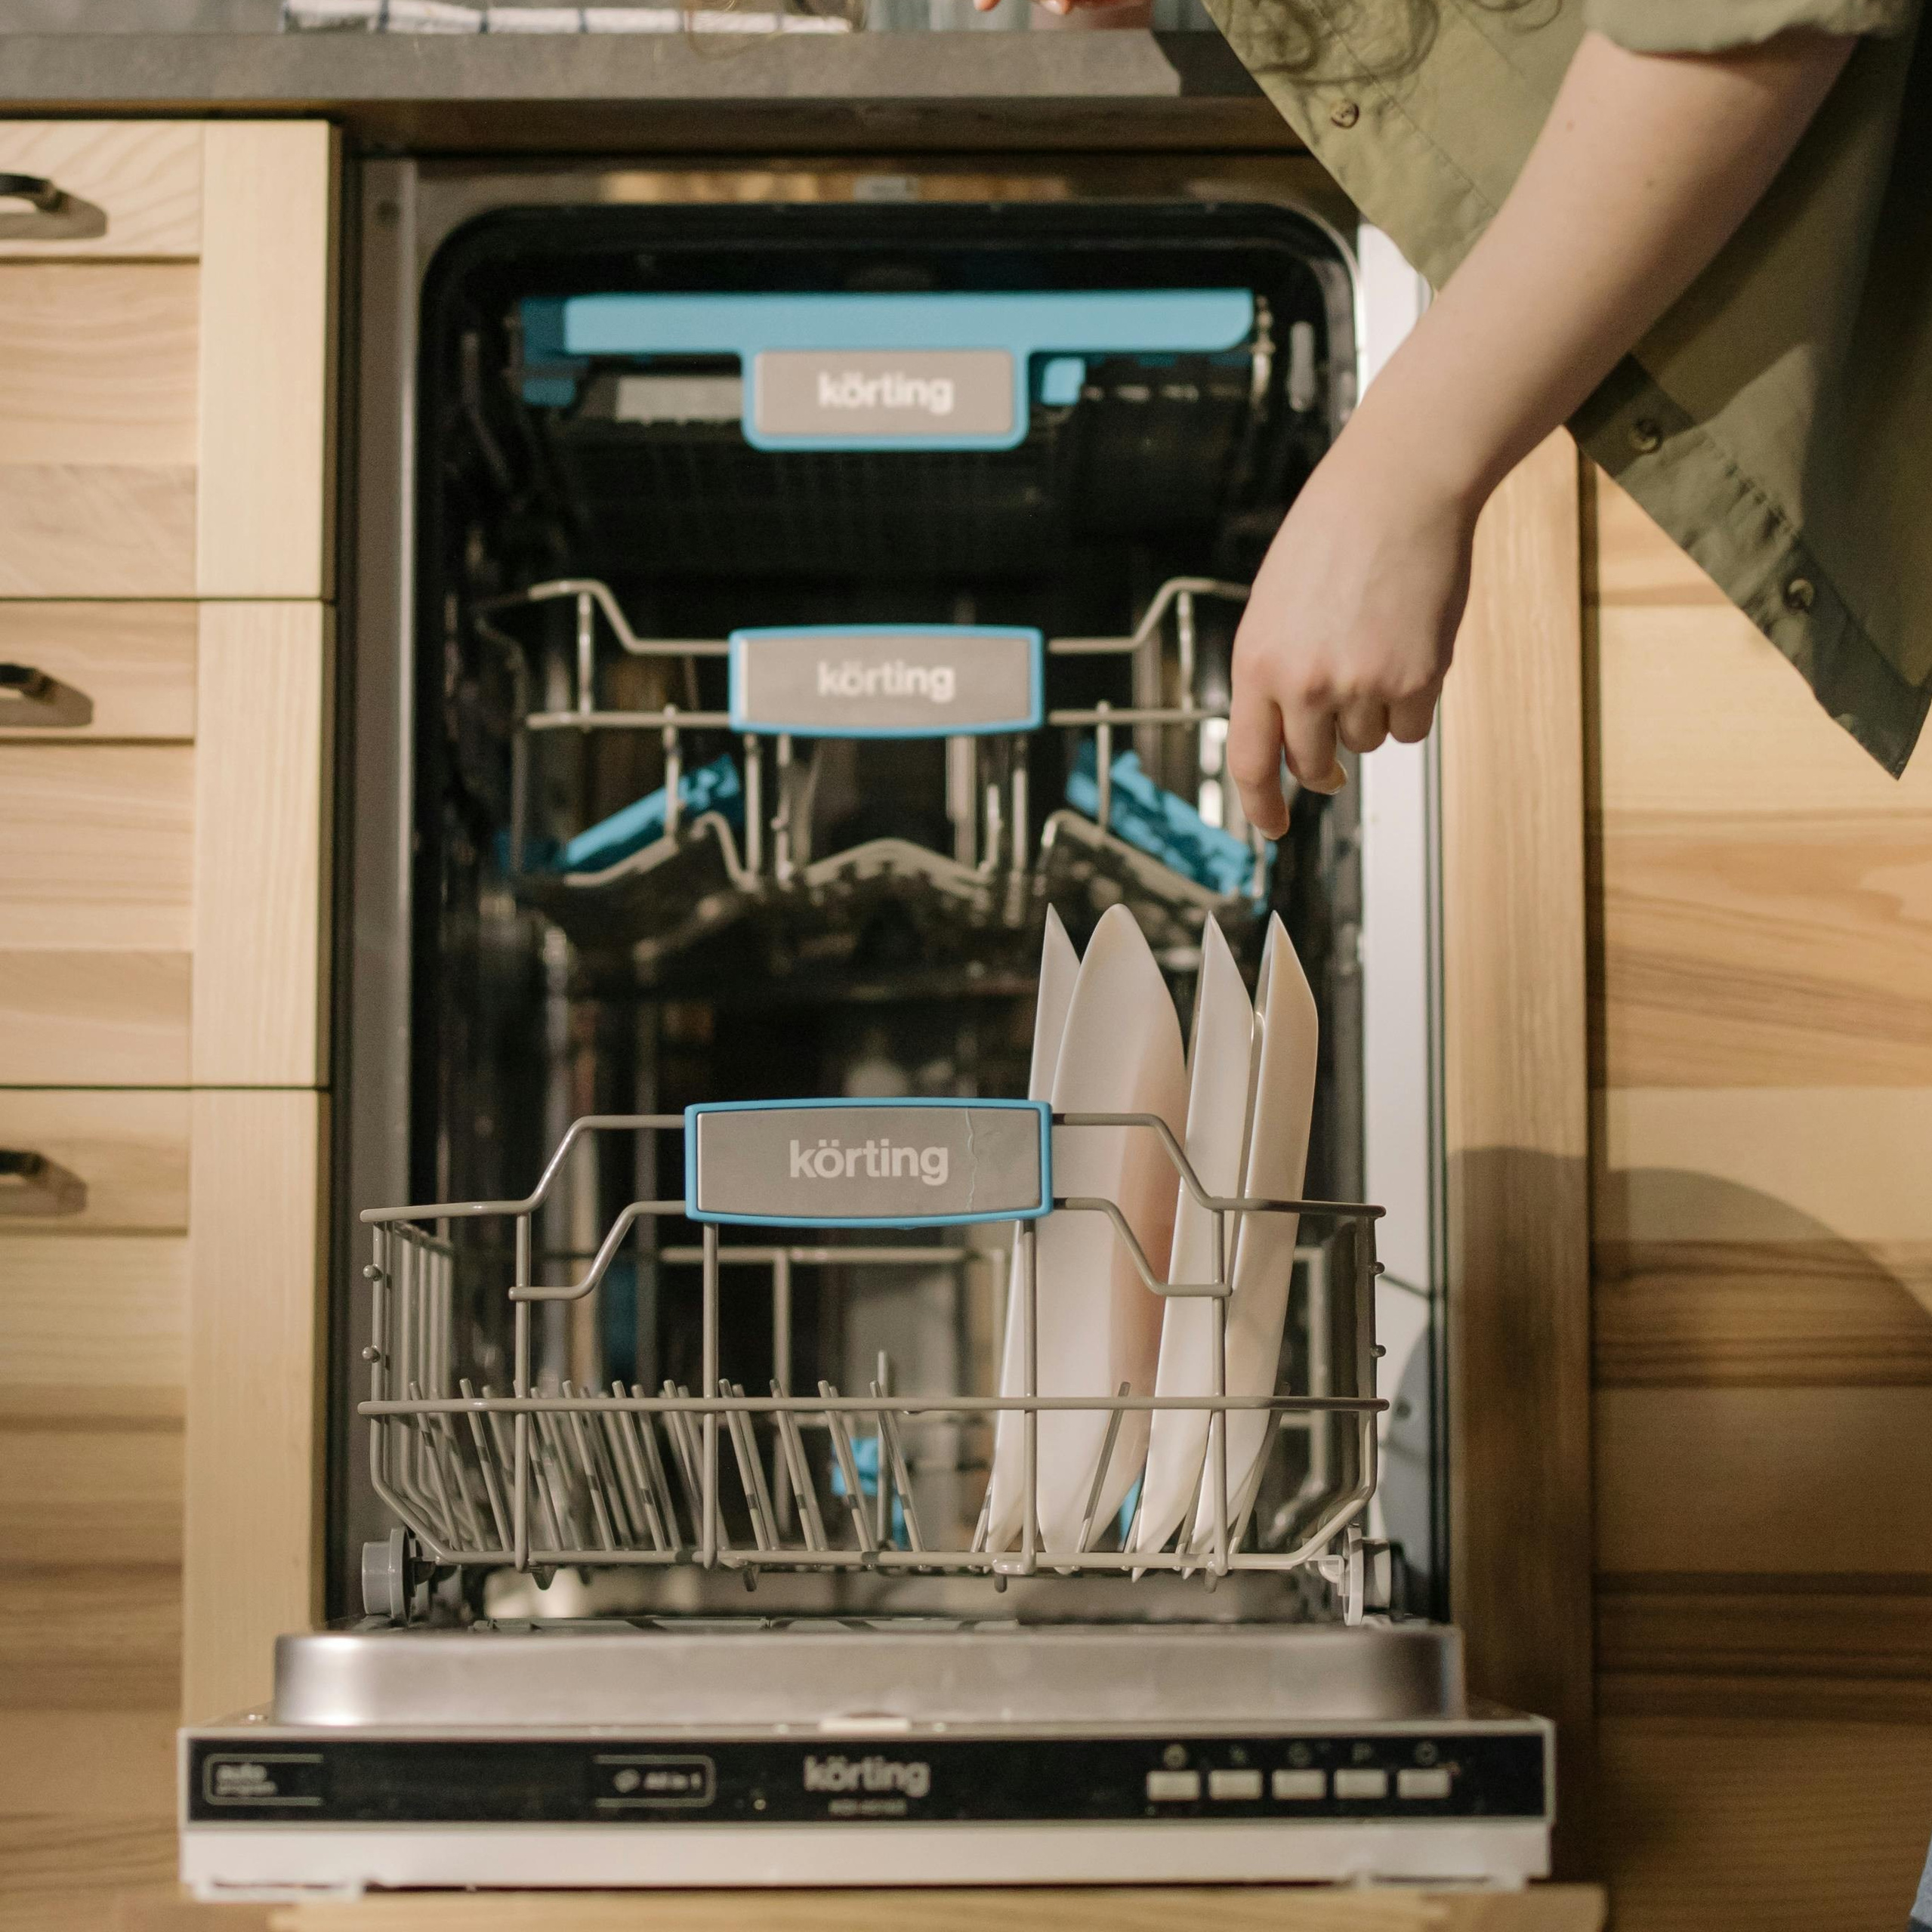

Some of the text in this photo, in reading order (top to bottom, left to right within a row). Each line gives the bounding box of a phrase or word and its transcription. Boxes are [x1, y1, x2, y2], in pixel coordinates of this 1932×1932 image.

[819, 372, 954, 415] körting
[817, 661, 955, 702] körting
[789, 1138, 949, 1186] körting
[804, 1755, 931, 1798] körting
